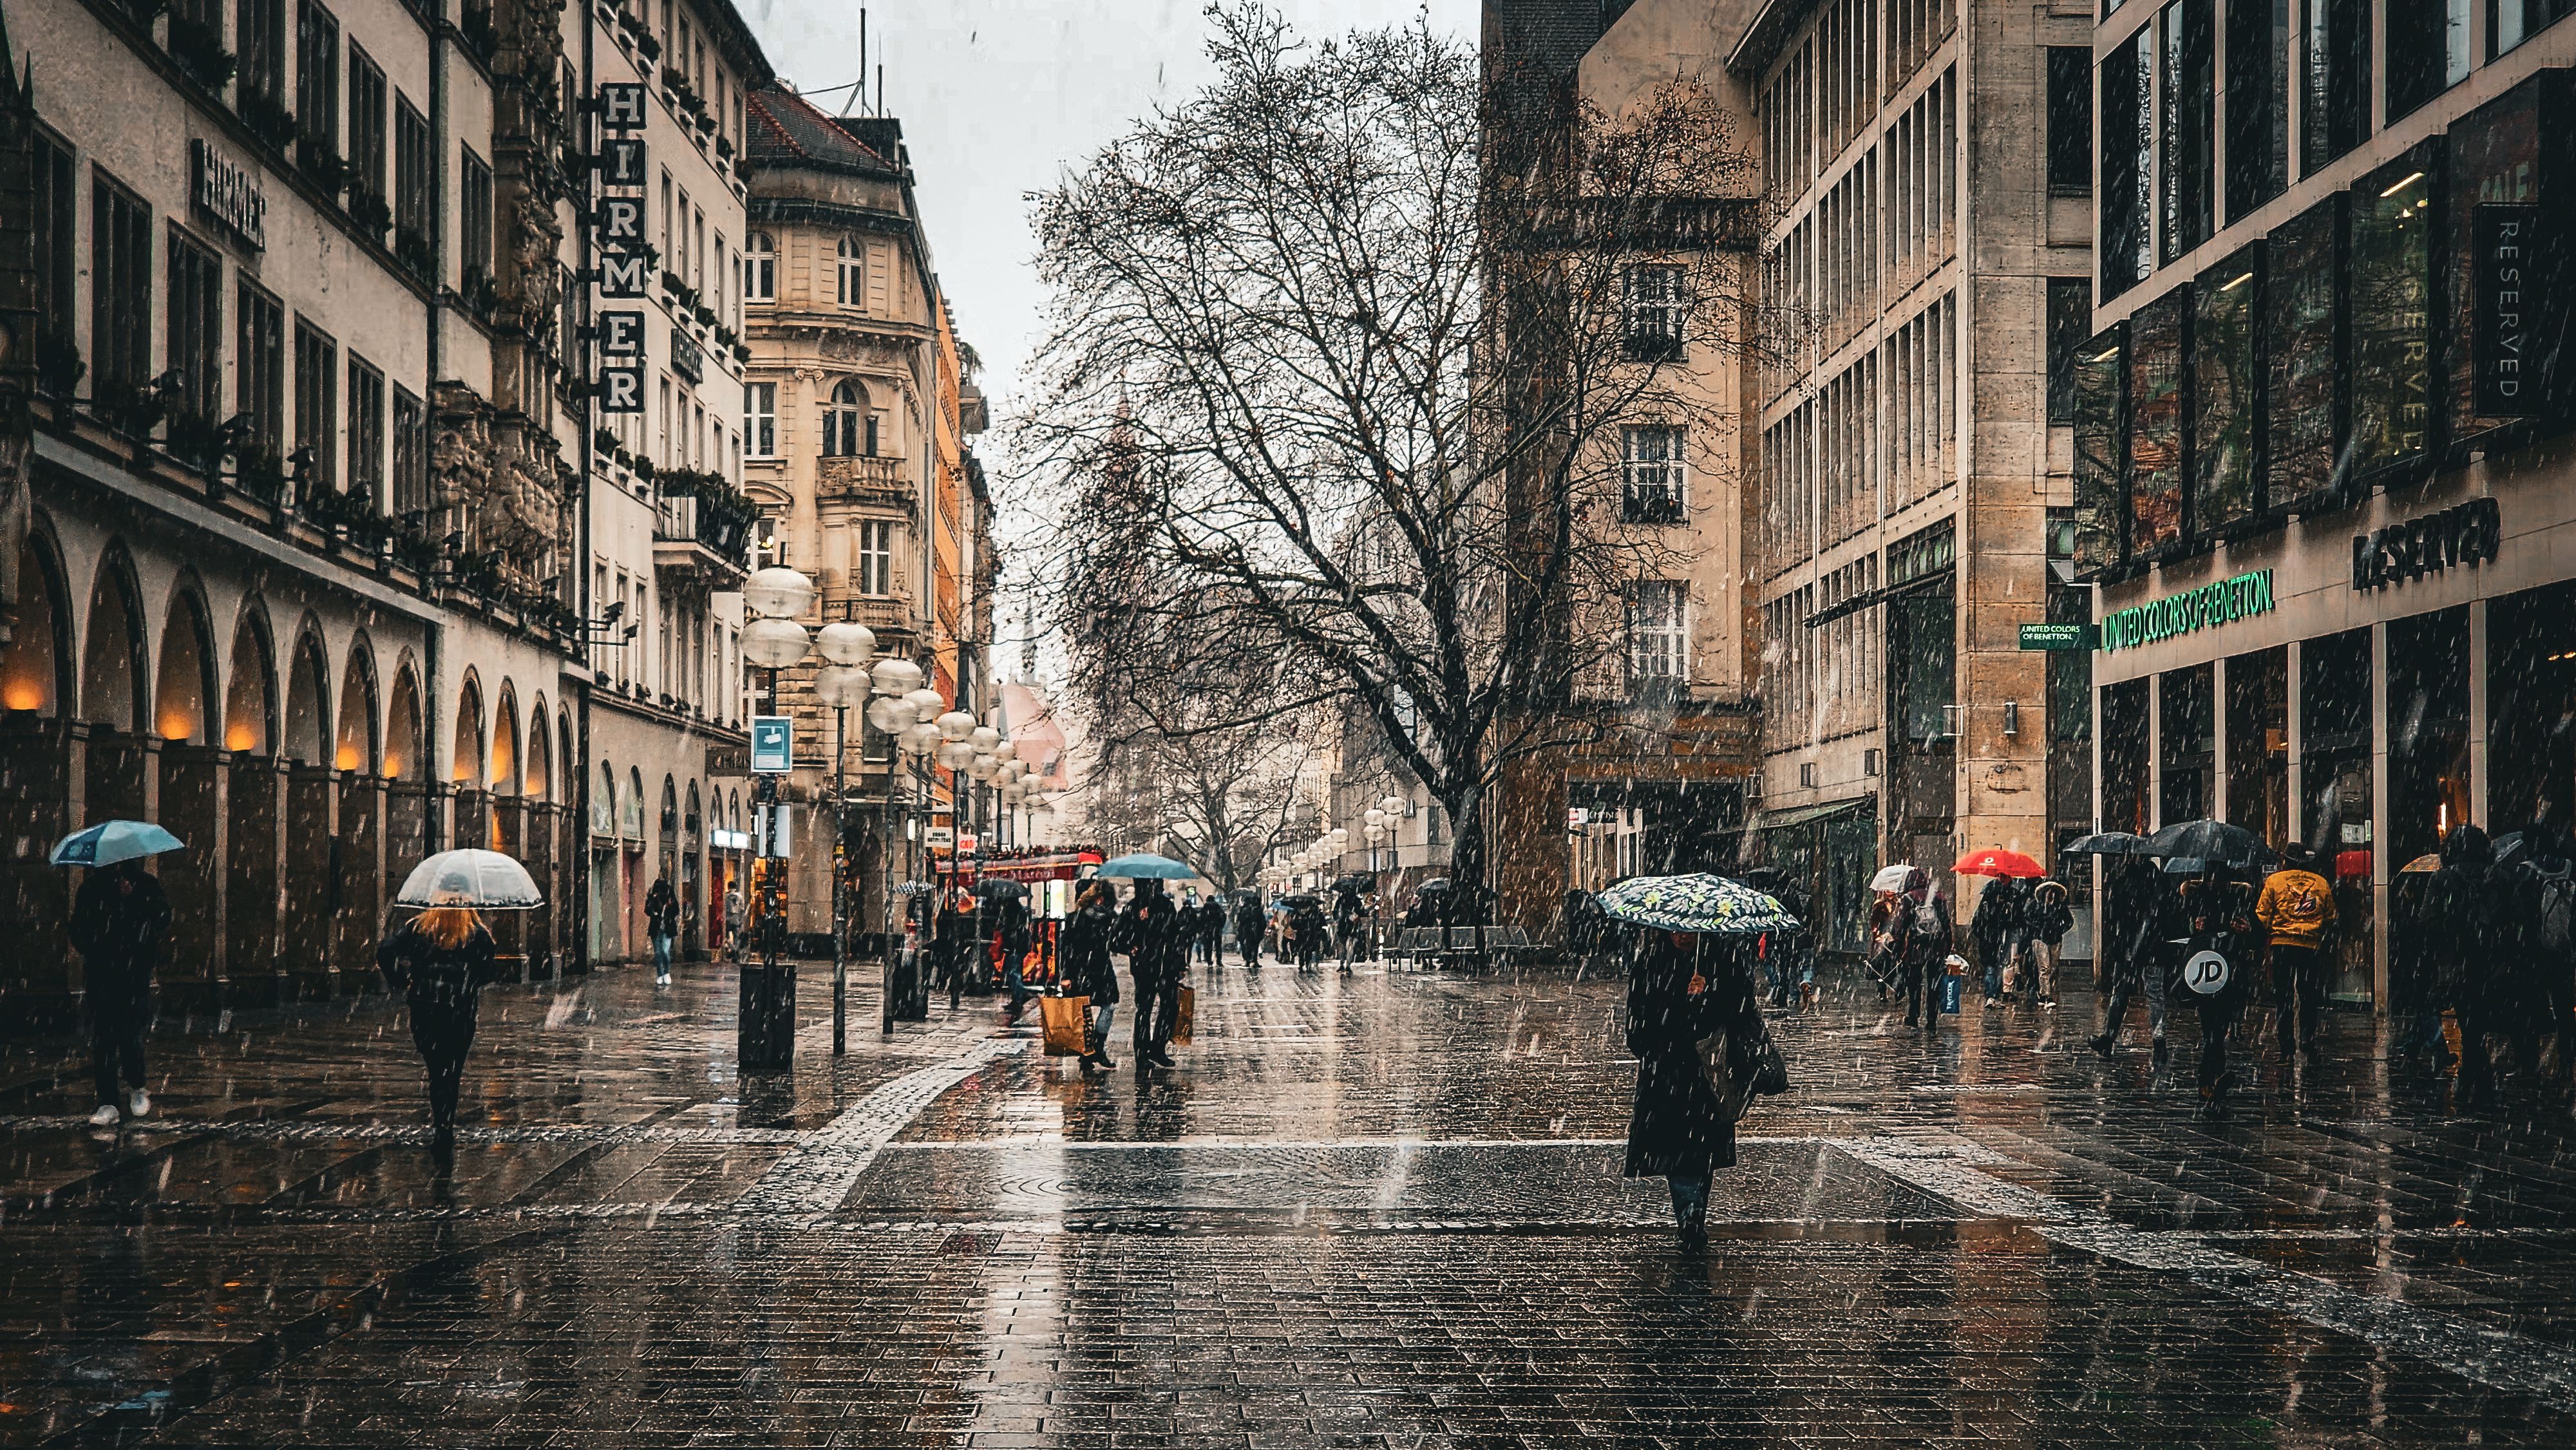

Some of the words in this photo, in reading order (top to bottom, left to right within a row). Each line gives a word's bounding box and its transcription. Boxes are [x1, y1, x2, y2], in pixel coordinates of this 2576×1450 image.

[602, 88, 643, 407] HIRMER
[2499, 222, 2519, 397] RESERVED
[2352, 496, 2501, 592] RESERVED
[2103, 607, 2143, 652] UNITED
[2143, 592, 2190, 642] COLORS
[2190, 587, 2209, 631] OF
[2192, 960, 2223, 986] JD
